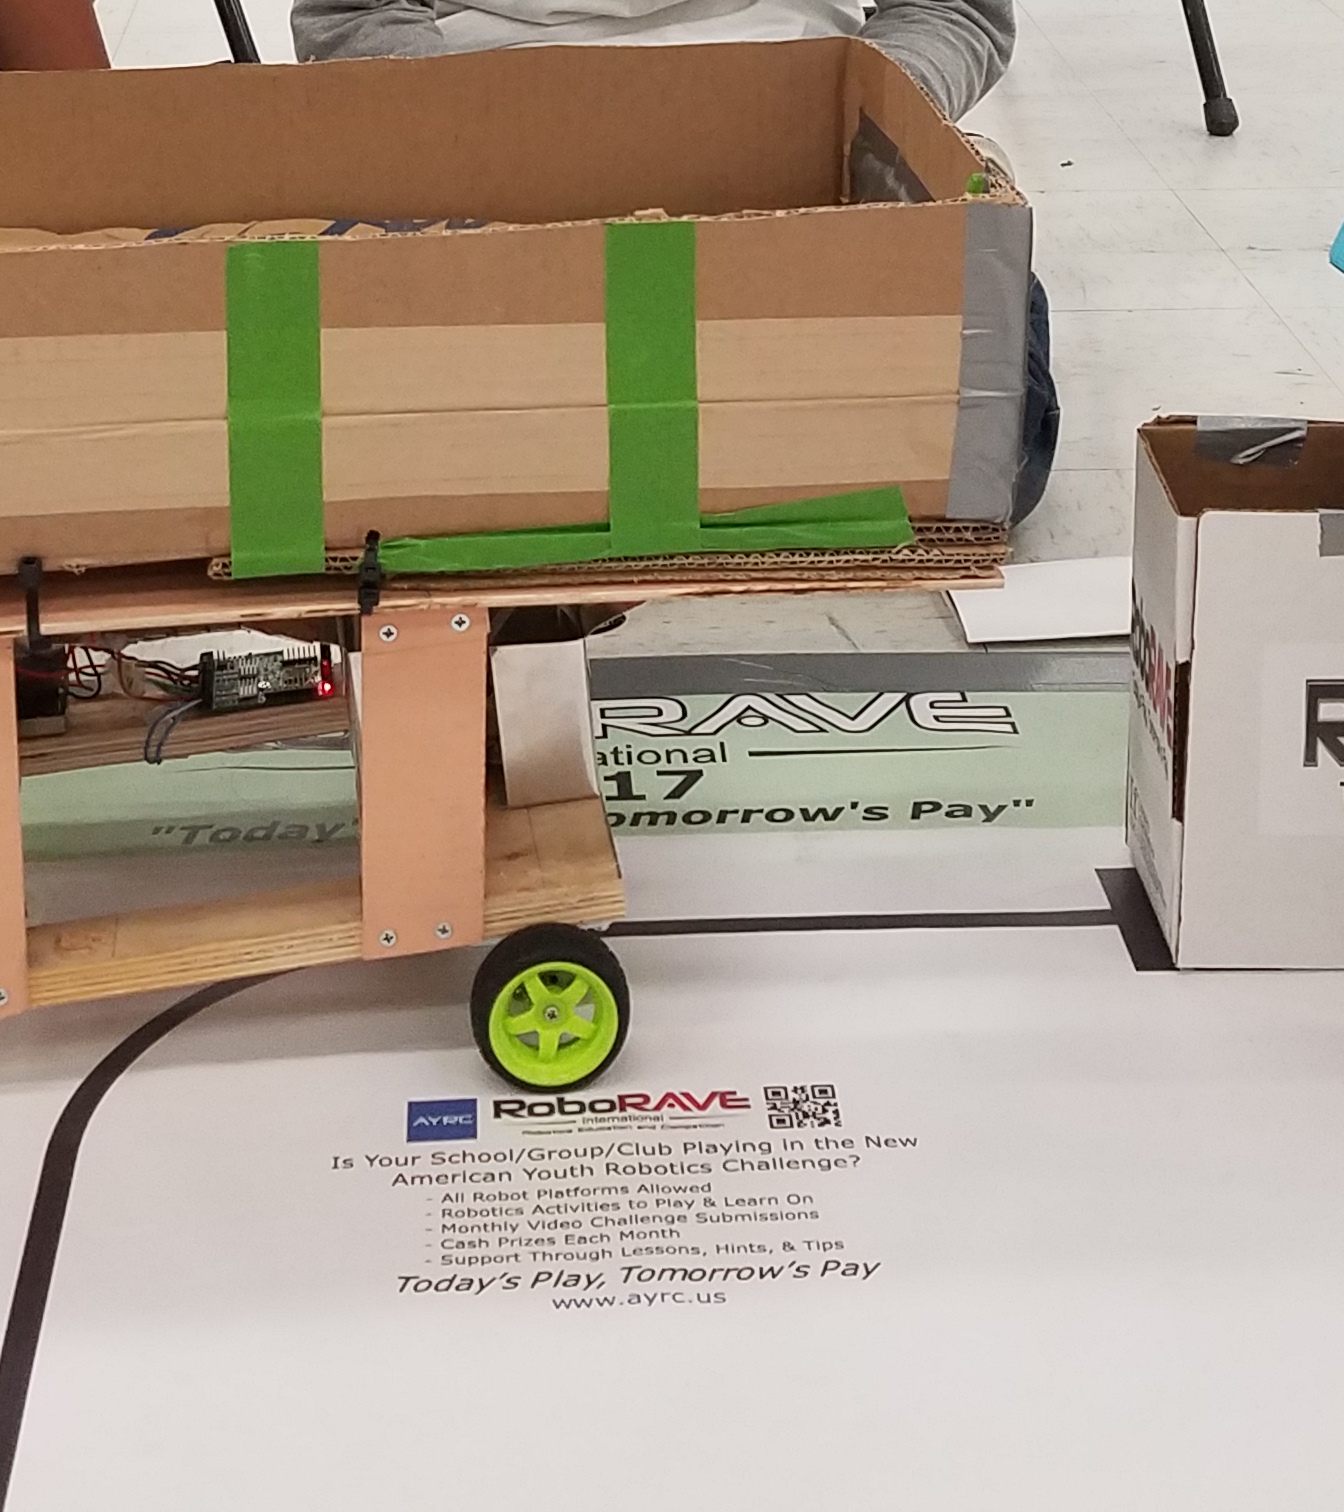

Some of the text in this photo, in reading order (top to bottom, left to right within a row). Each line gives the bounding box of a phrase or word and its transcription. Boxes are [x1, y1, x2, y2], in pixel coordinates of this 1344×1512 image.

[604, 769, 704, 801] 17
[910, 798, 1036, 824] Pay"
[492, 1091, 752, 1118] RoboRAVE
[582, 1113, 665, 1126] International
[331, 1135, 918, 1169] Is Your School/Group/Club Playing in the New
[392, 1154, 862, 1186] American Youth Robotics Challenge?
[441, 1182, 712, 1204] All Robot Platforms Allowed
[441, 1193, 814, 1219] Robotics Activities to Play & Learn On
[441, 1208, 820, 1235] Monthly Video Challenge Submissions
[440, 1228, 681, 1250] Cash Prizes Each Month
[440, 1238, 845, 1267] Support Through Lessons, Hints, & Tips
[396, 1259, 882, 1295] Today's Play, Tomorrow's Pay
[551, 1289, 727, 1310] www.ayrc.us
